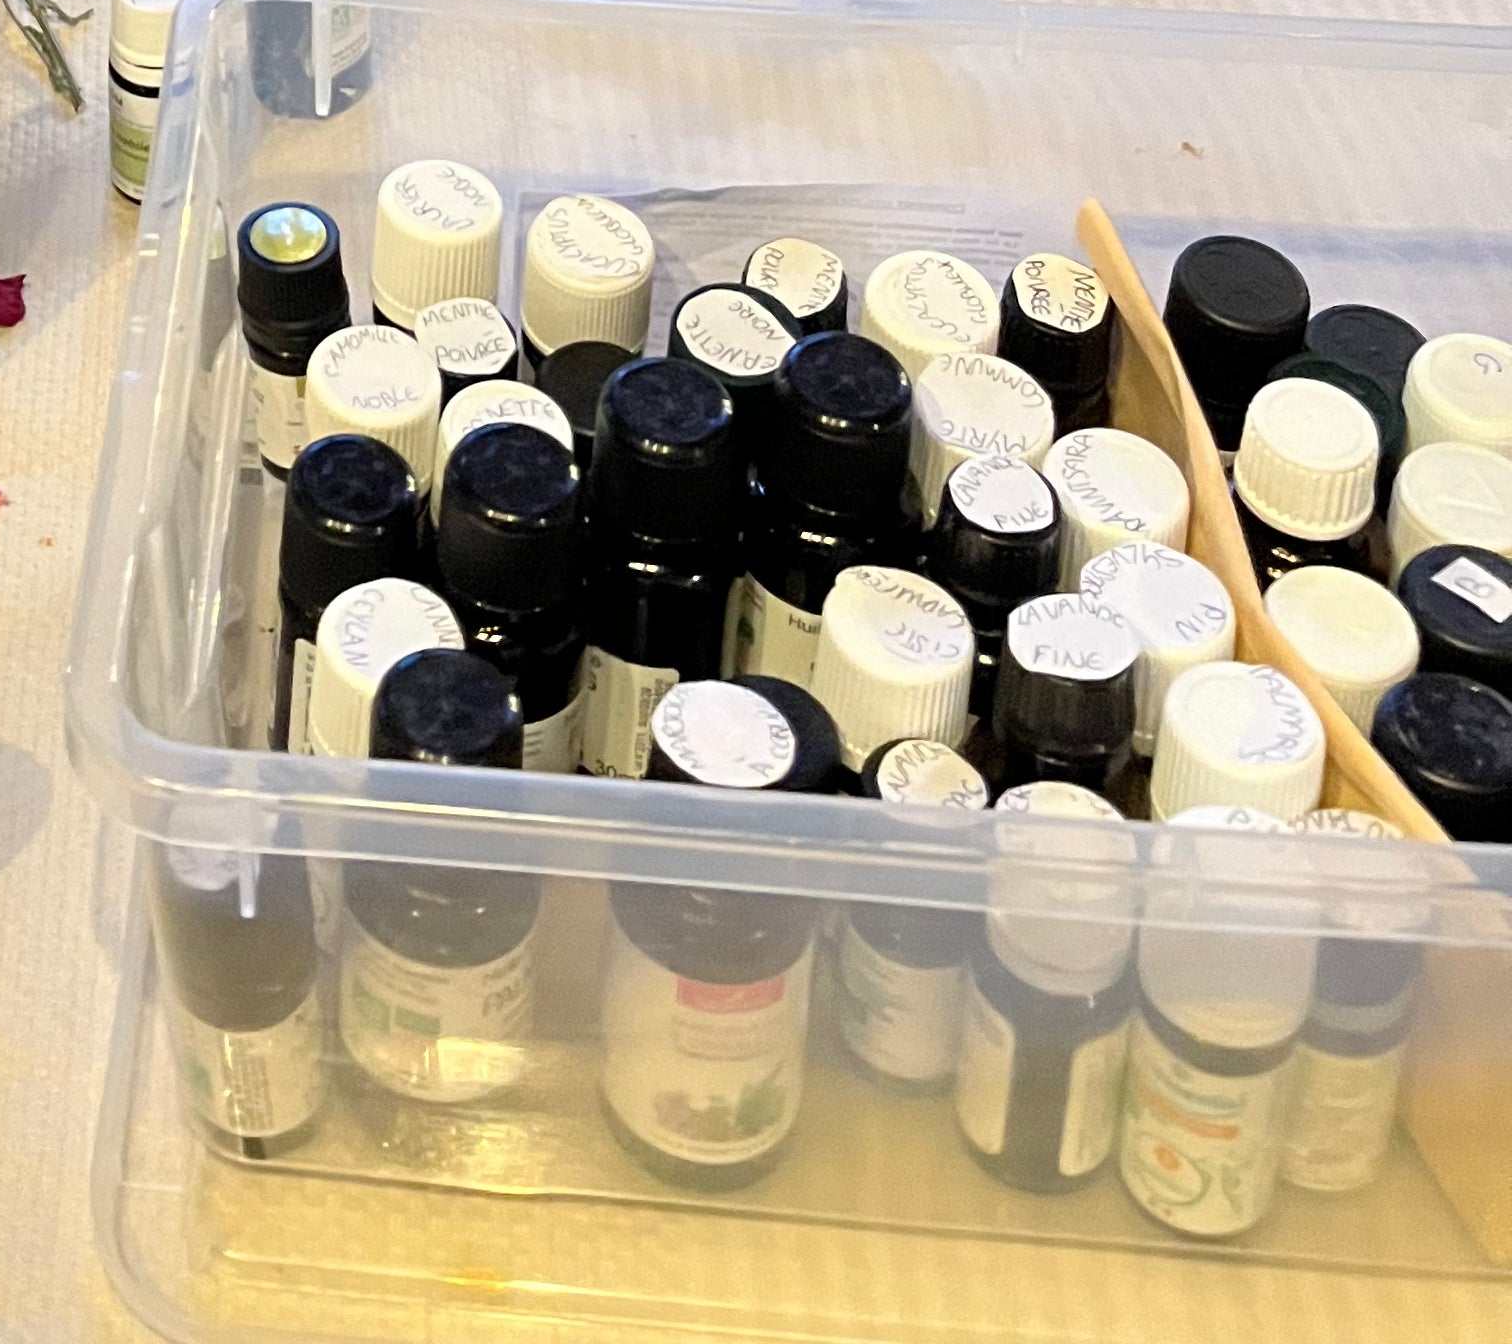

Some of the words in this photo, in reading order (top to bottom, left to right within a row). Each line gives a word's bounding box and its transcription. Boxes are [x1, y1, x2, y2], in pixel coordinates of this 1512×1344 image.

[423, 302, 496, 327] MENTHE
[940, 354, 1044, 408] COMMUNE
[352, 386, 418, 409] NOBLE
[940, 419, 1027, 454] MYRTE
[993, 501, 1048, 530] FINE
[788, 614, 821, 635] Huil
[1017, 595, 1124, 629] LAVANDE
[1176, 603, 1227, 641] PIN
[884, 621, 960, 658] CISTE
[1033, 644, 1105, 671] FINE
